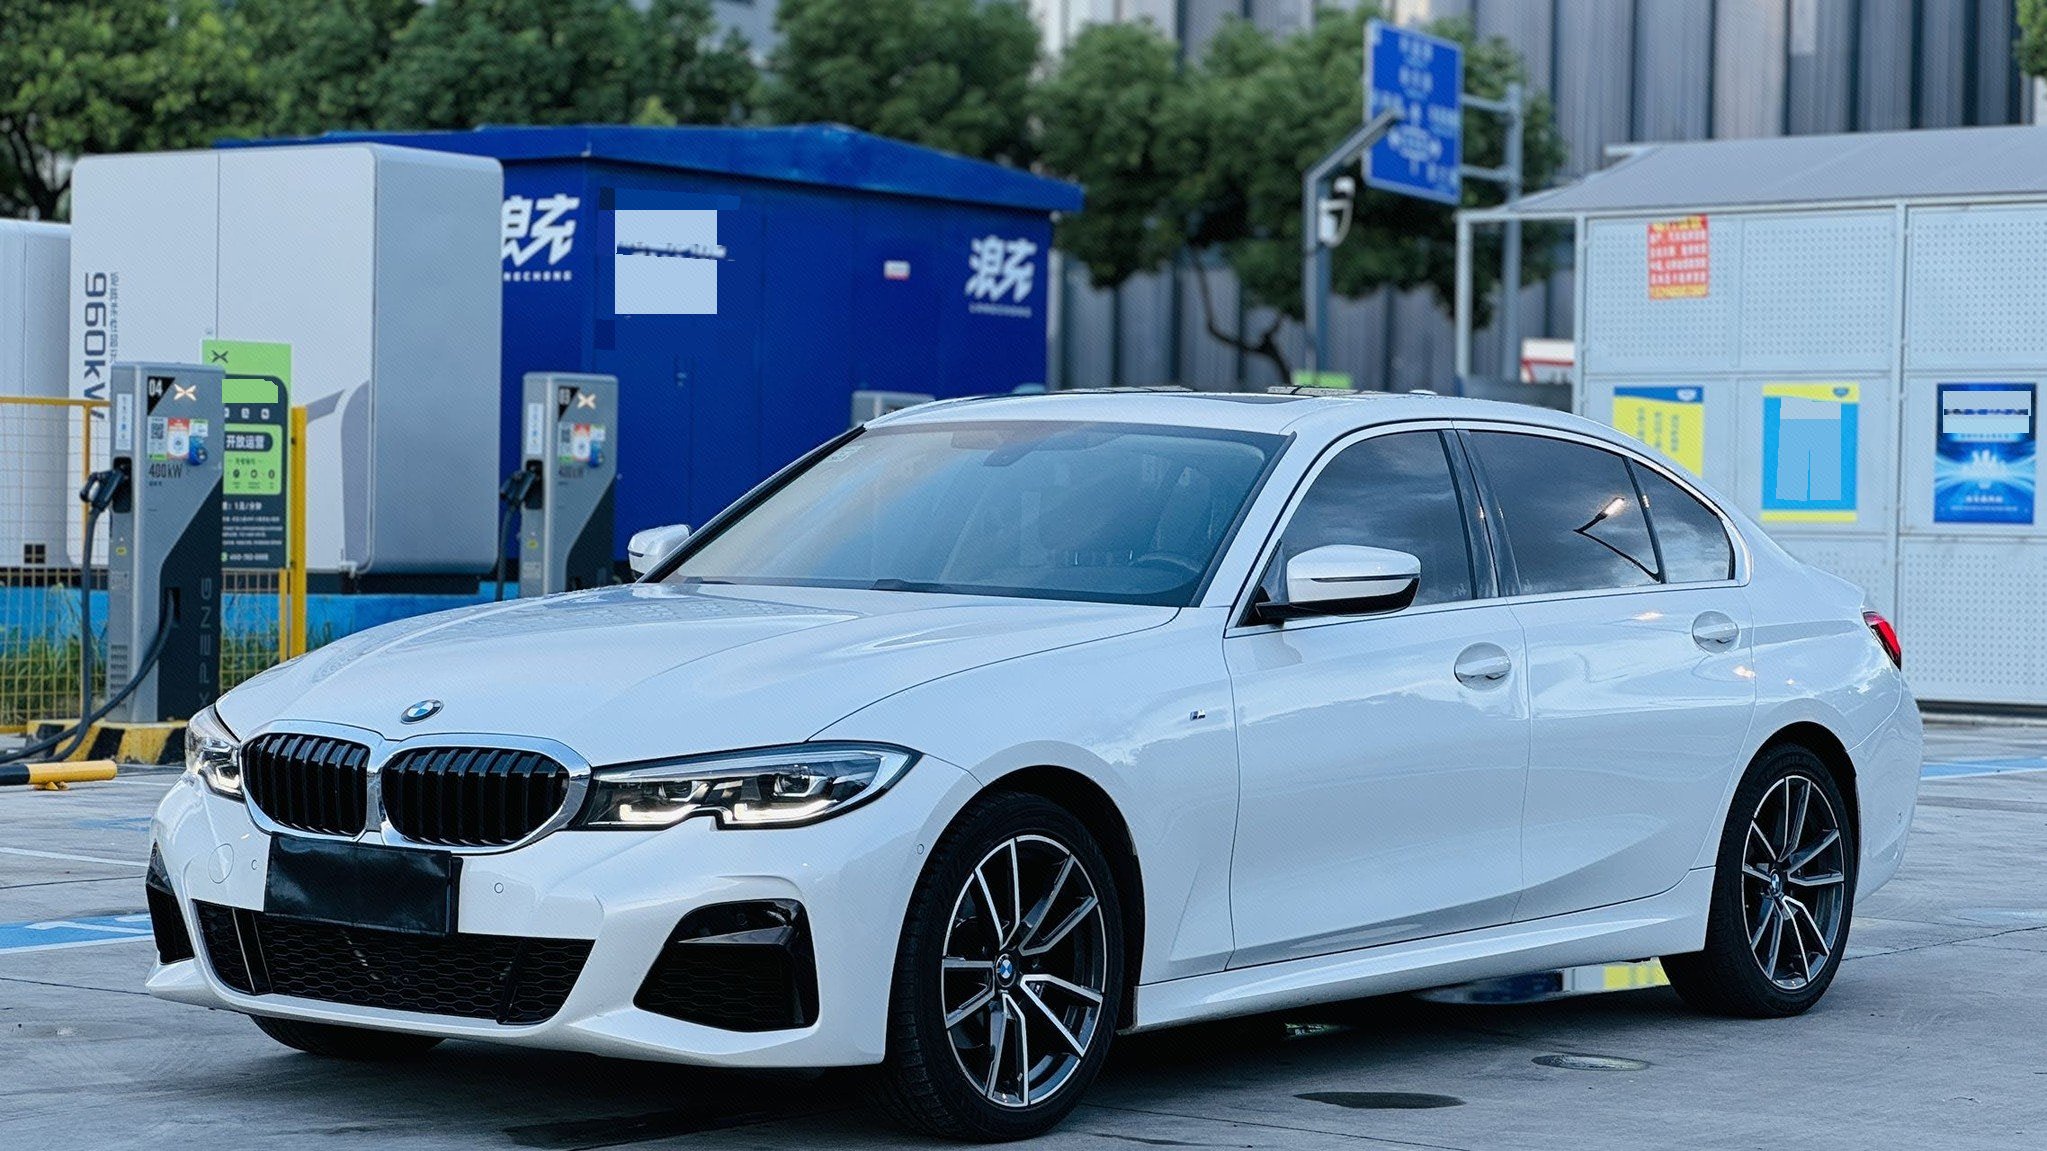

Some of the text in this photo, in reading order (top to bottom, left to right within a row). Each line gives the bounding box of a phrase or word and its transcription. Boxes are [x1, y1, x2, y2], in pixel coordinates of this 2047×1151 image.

[149, 379, 163, 397] 04
[226, 434, 265, 450] 开放运营
[149, 463, 183, 479] 400kW
